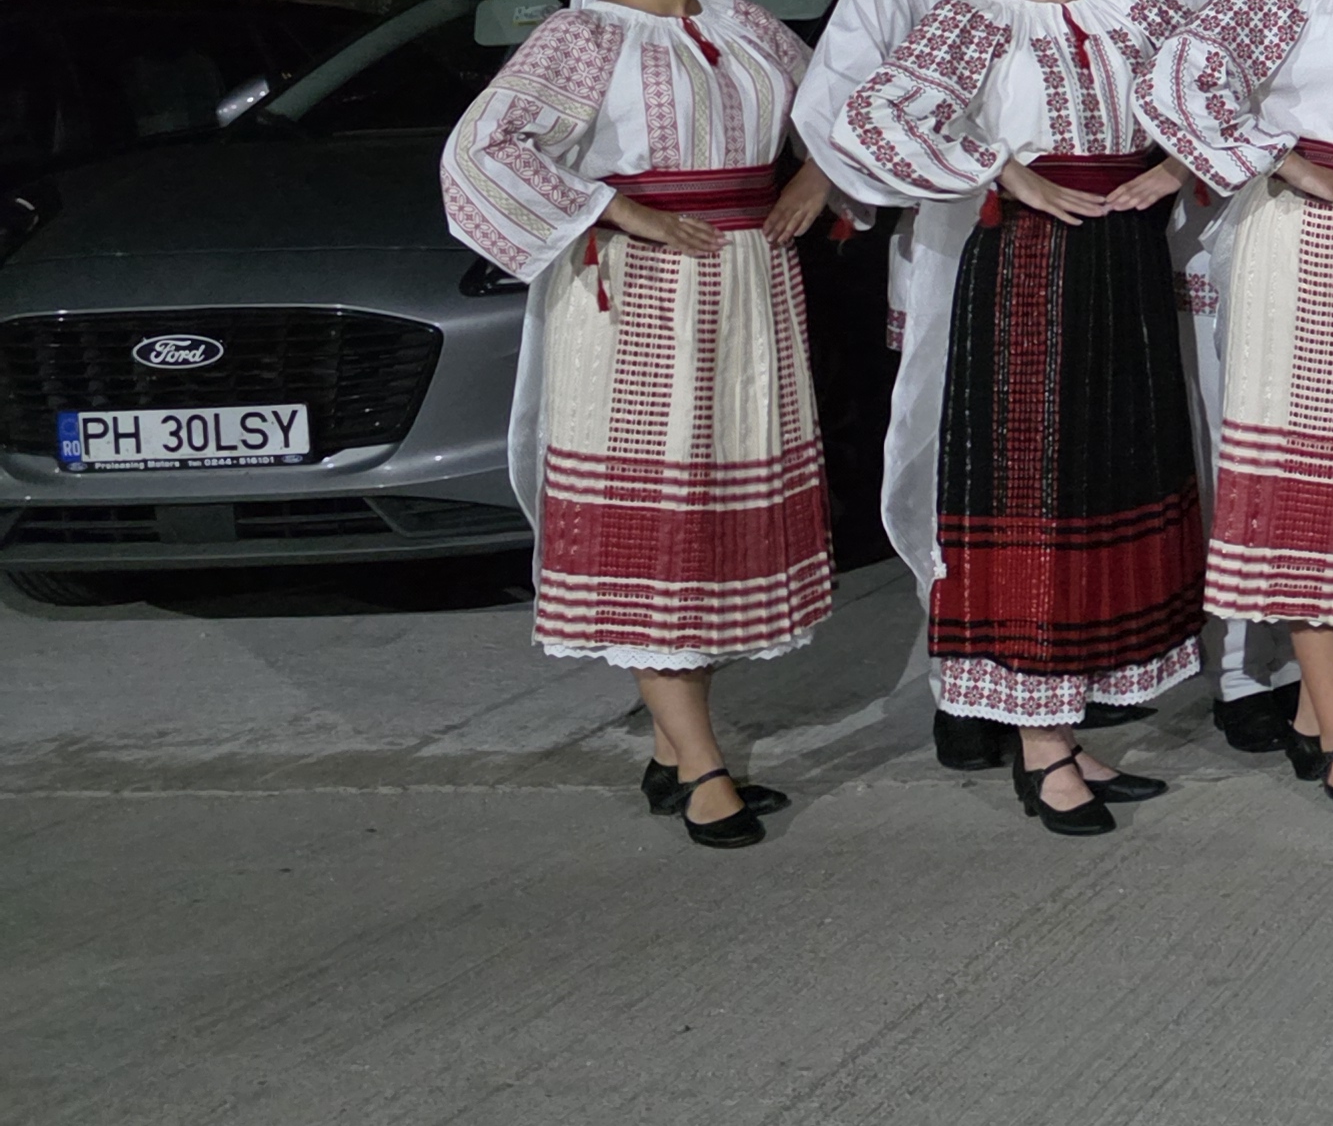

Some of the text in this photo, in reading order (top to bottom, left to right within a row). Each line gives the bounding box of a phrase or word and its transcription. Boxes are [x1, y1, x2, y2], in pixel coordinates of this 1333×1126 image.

[150, 340, 206, 363] Ford
[82, 410, 298, 455] PH 30LSY
[63, 440, 81, 457] RO
